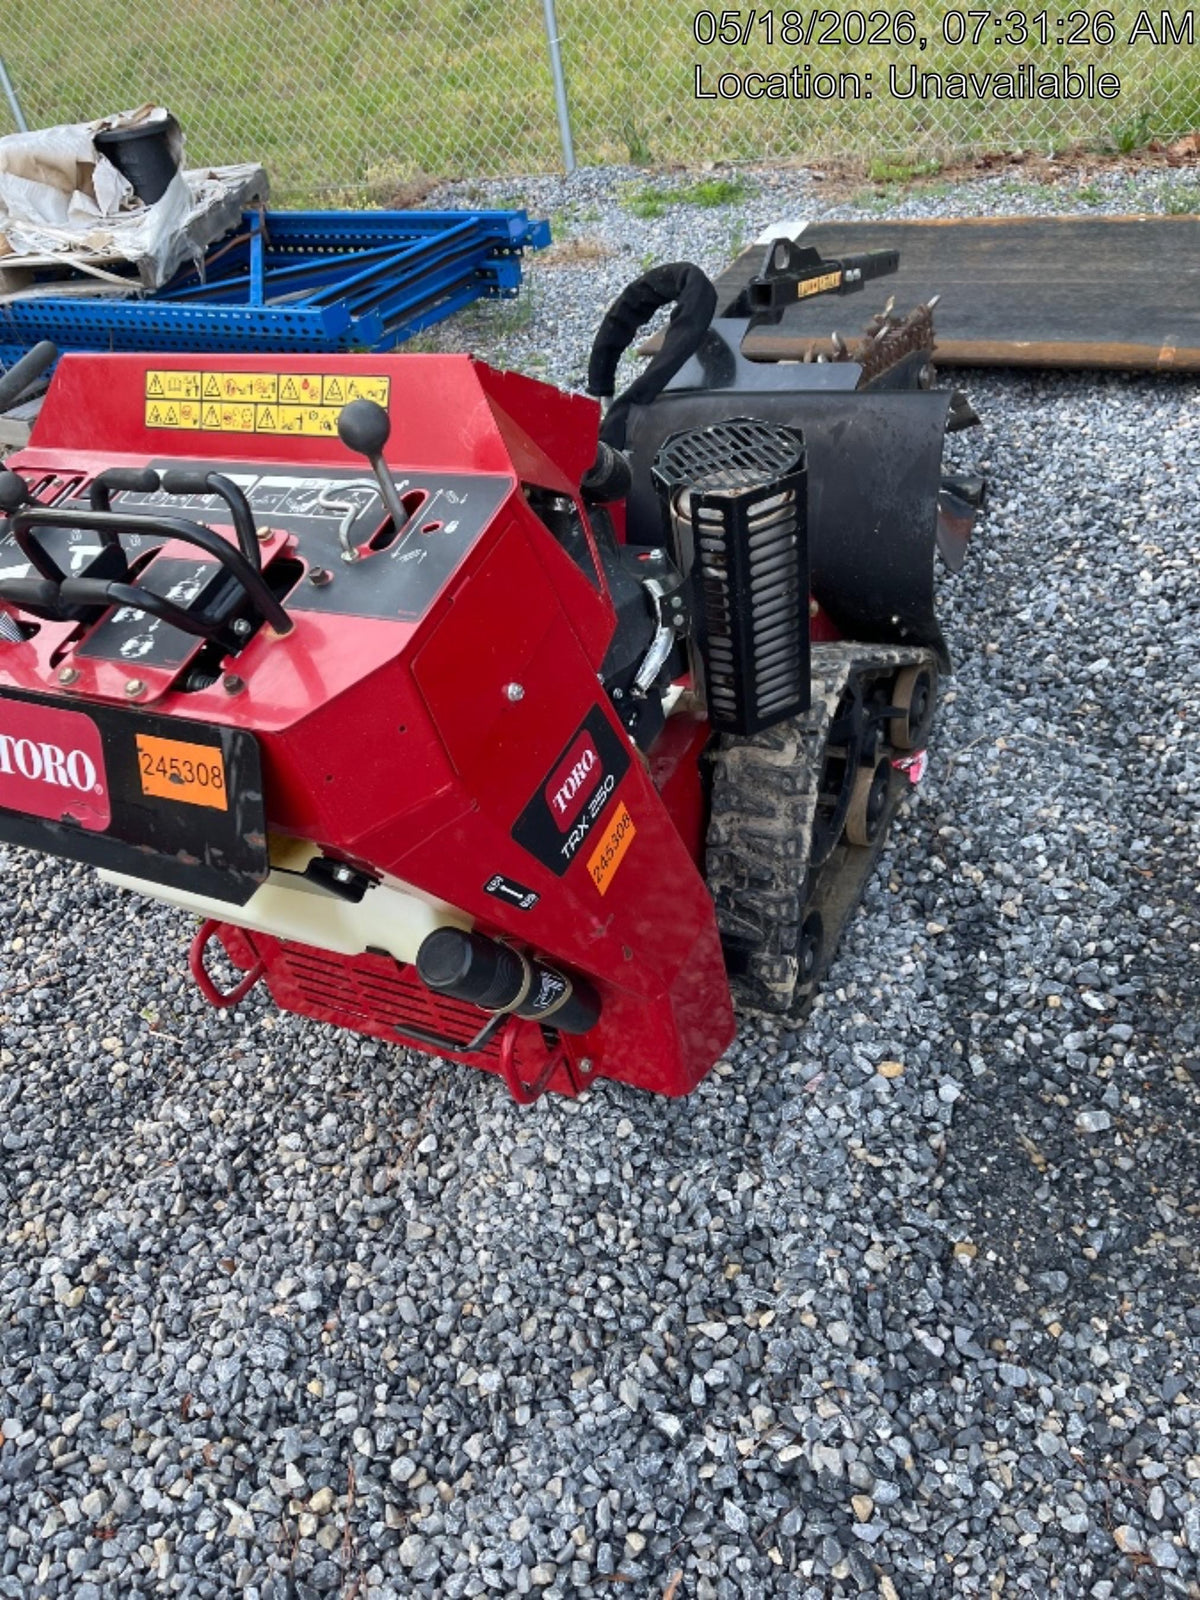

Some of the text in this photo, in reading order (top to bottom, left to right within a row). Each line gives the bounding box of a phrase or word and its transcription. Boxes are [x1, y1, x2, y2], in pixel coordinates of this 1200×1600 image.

[0, 734, 97, 792] TORO
[142, 753, 223, 789] 245308
[553, 749, 597, 814] TORO
[561, 774, 615, 859] TRX 250
[593, 812, 631, 884] 245308
